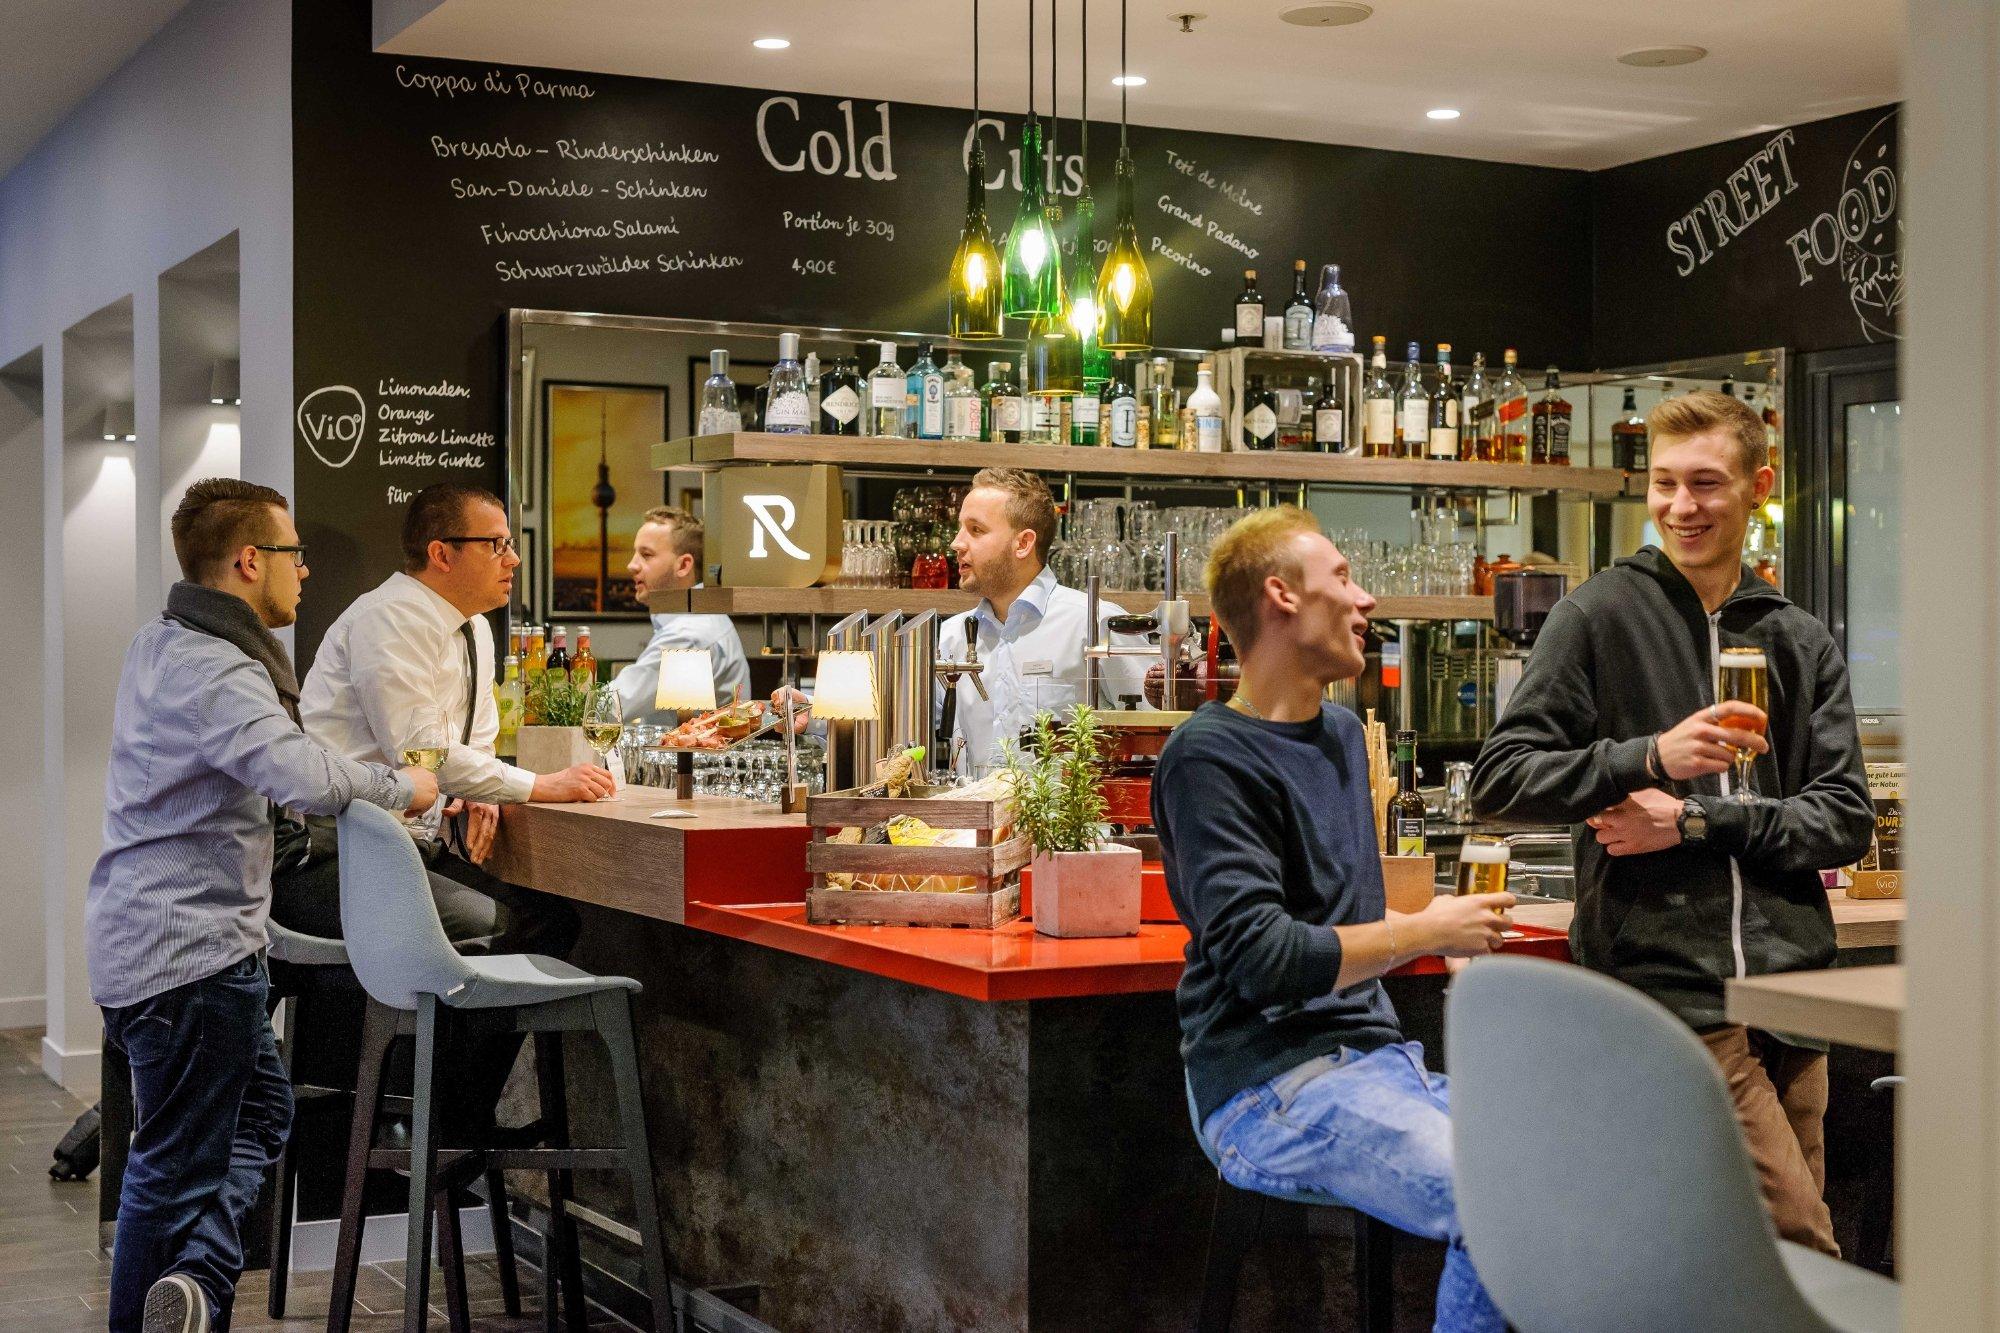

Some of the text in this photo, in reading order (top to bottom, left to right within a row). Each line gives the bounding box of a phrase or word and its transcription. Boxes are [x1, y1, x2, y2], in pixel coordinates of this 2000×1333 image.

[396, 65, 595, 99] Coppa di Parma
[555, 139, 719, 164] Rinderschinken
[756, 97, 898, 181] Cold
[450, 178, 594, 199] San-Daniele
[615, 178, 708, 199] Schinken
[1666, 129, 1799, 277] STREET
[480, 216, 680, 245] Finocchiona Salami
[782, 211, 895, 241] Portion je 30g
[1157, 195, 1260, 260] Grand Padano
[1786, 166, 1897, 287] FOOD
[495, 250, 745, 281] Schwarzwälder Schinken
[791, 257, 837, 276] 4,90€
[1151, 236, 1212, 276] Pecorino
[378, 403, 435, 426] Orange
[378, 427, 496, 448] Zitrone Limette
[379, 449, 485, 469] Limette Gurke
[387, 485, 413, 505] für
[743, 494, 811, 561] R
[1877, 815, 1905, 828] DURS
